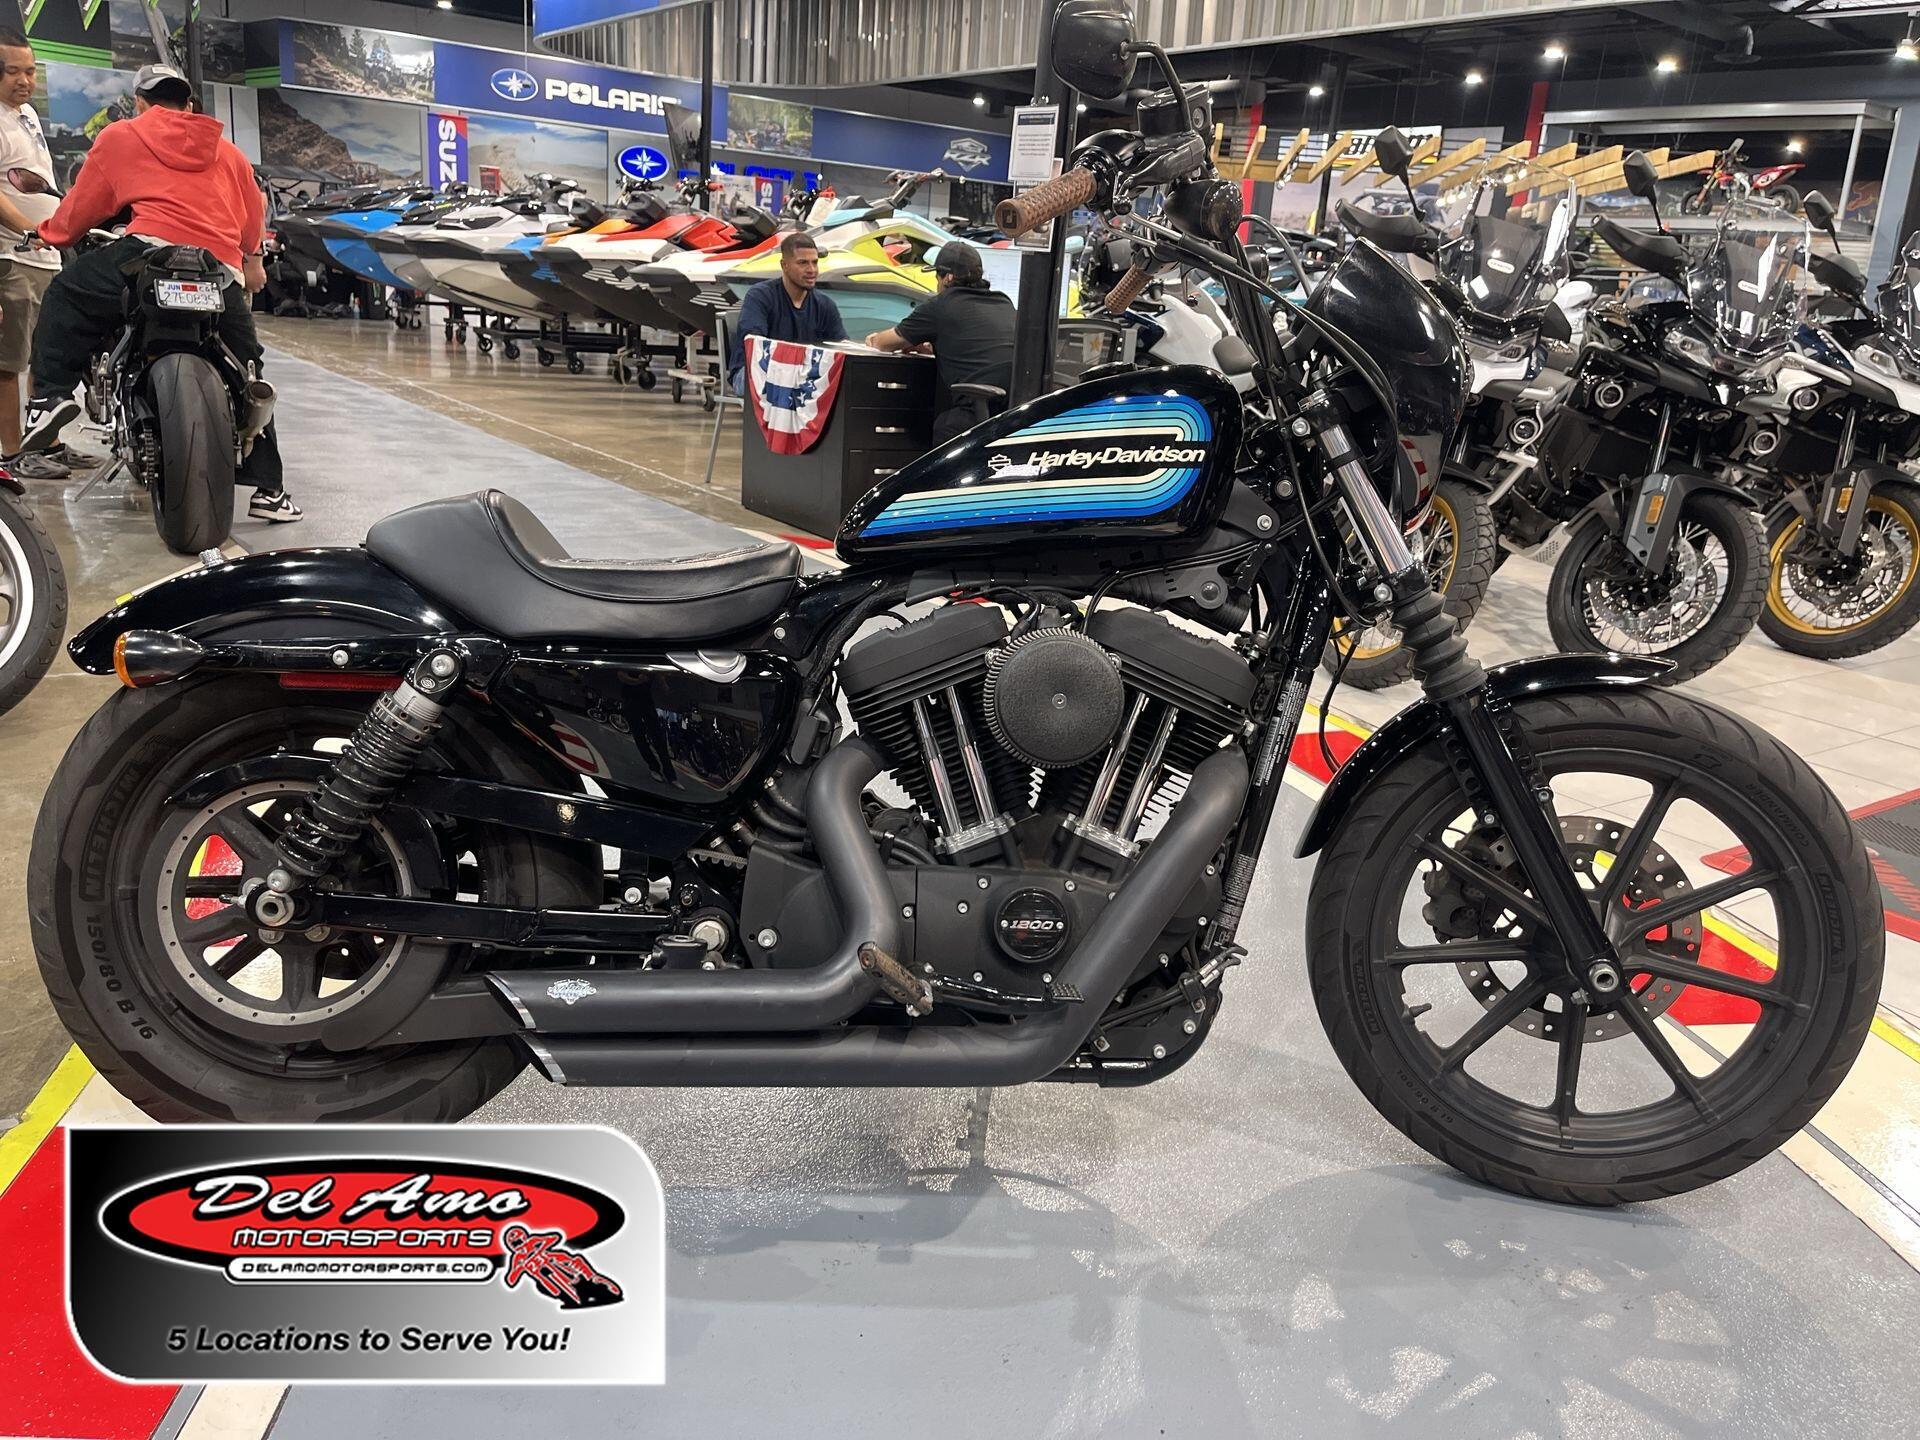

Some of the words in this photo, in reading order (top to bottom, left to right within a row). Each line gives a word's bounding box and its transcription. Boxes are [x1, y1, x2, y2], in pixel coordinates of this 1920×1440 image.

[545, 78, 677, 116] POLARIS
[437, 118, 458, 194] SUZ
[1028, 445, 1206, 469] Harley-Davidson
[87, 914, 122, 992] 150/80
[116, 999, 136, 1014] B
[131, 1016, 158, 1040] 16
[1354, 962, 1380, 1033] MICHELIN
